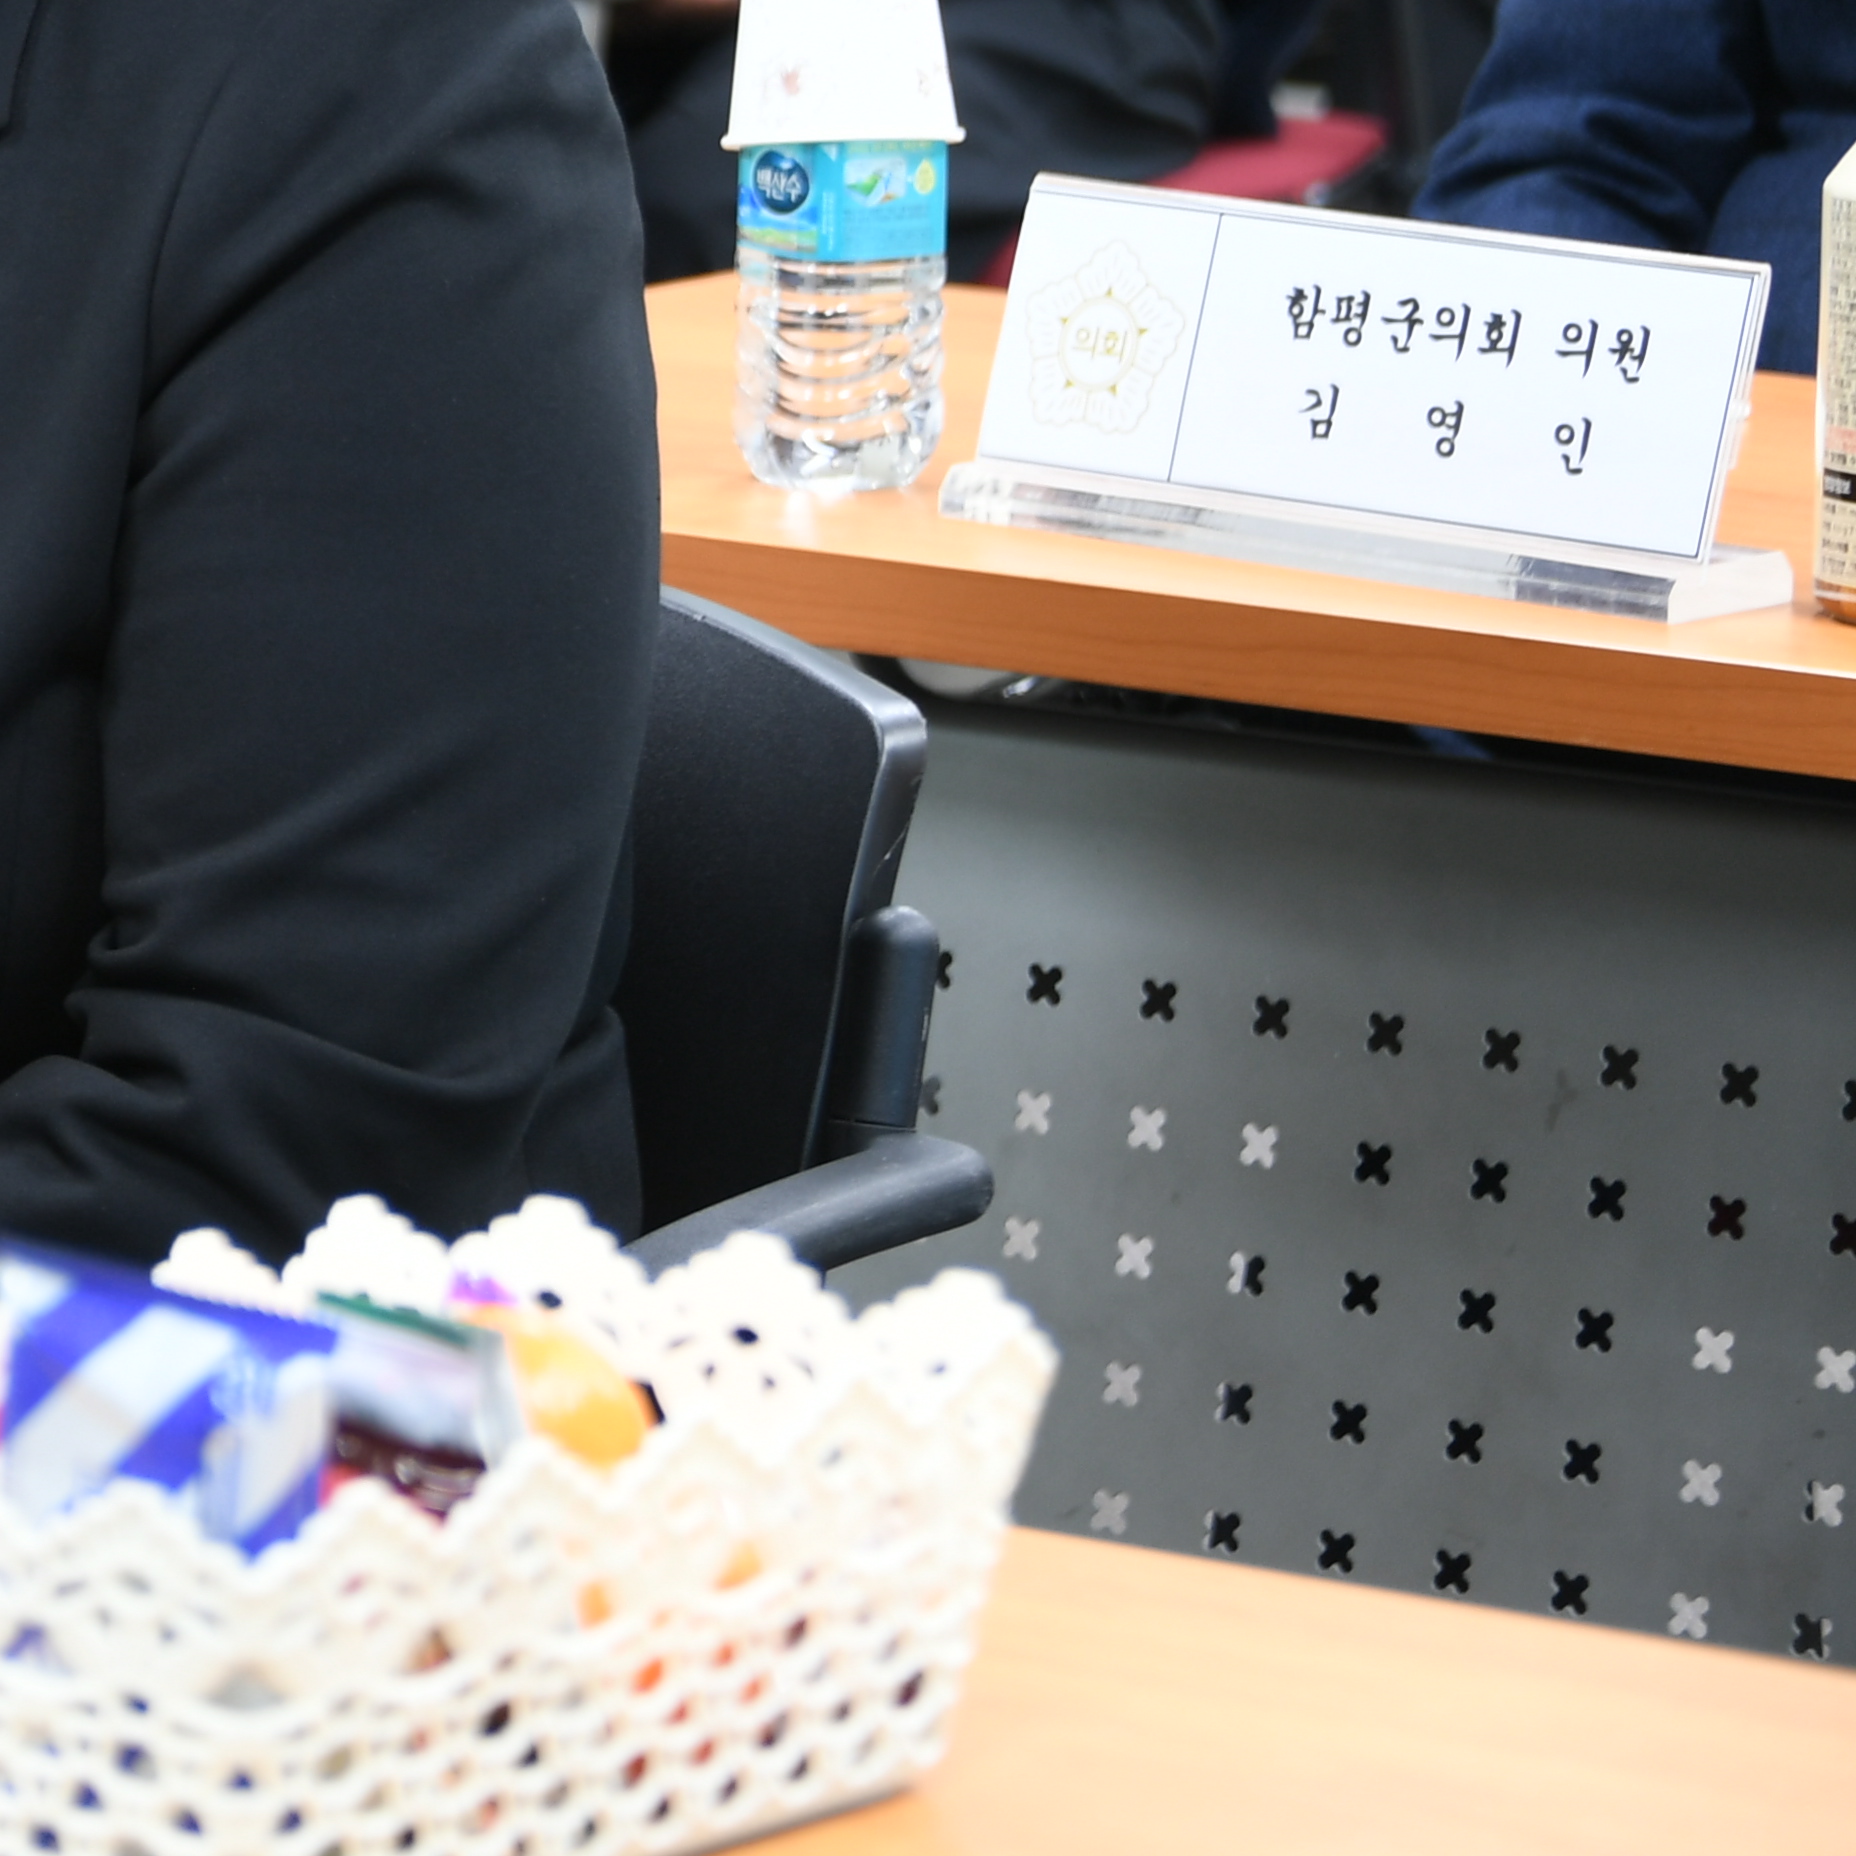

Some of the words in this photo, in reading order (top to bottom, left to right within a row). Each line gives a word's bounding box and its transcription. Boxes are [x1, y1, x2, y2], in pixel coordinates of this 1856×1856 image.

[756, 168, 802, 203] 백산수
[1071, 326, 1128, 365] 의회
[1286, 284, 1523, 368] 함평군의회
[1555, 318, 1651, 384] 의원
[1301, 383, 1340, 440] 김
[1426, 400, 1465, 459] 영
[1554, 417, 1593, 476] 인
